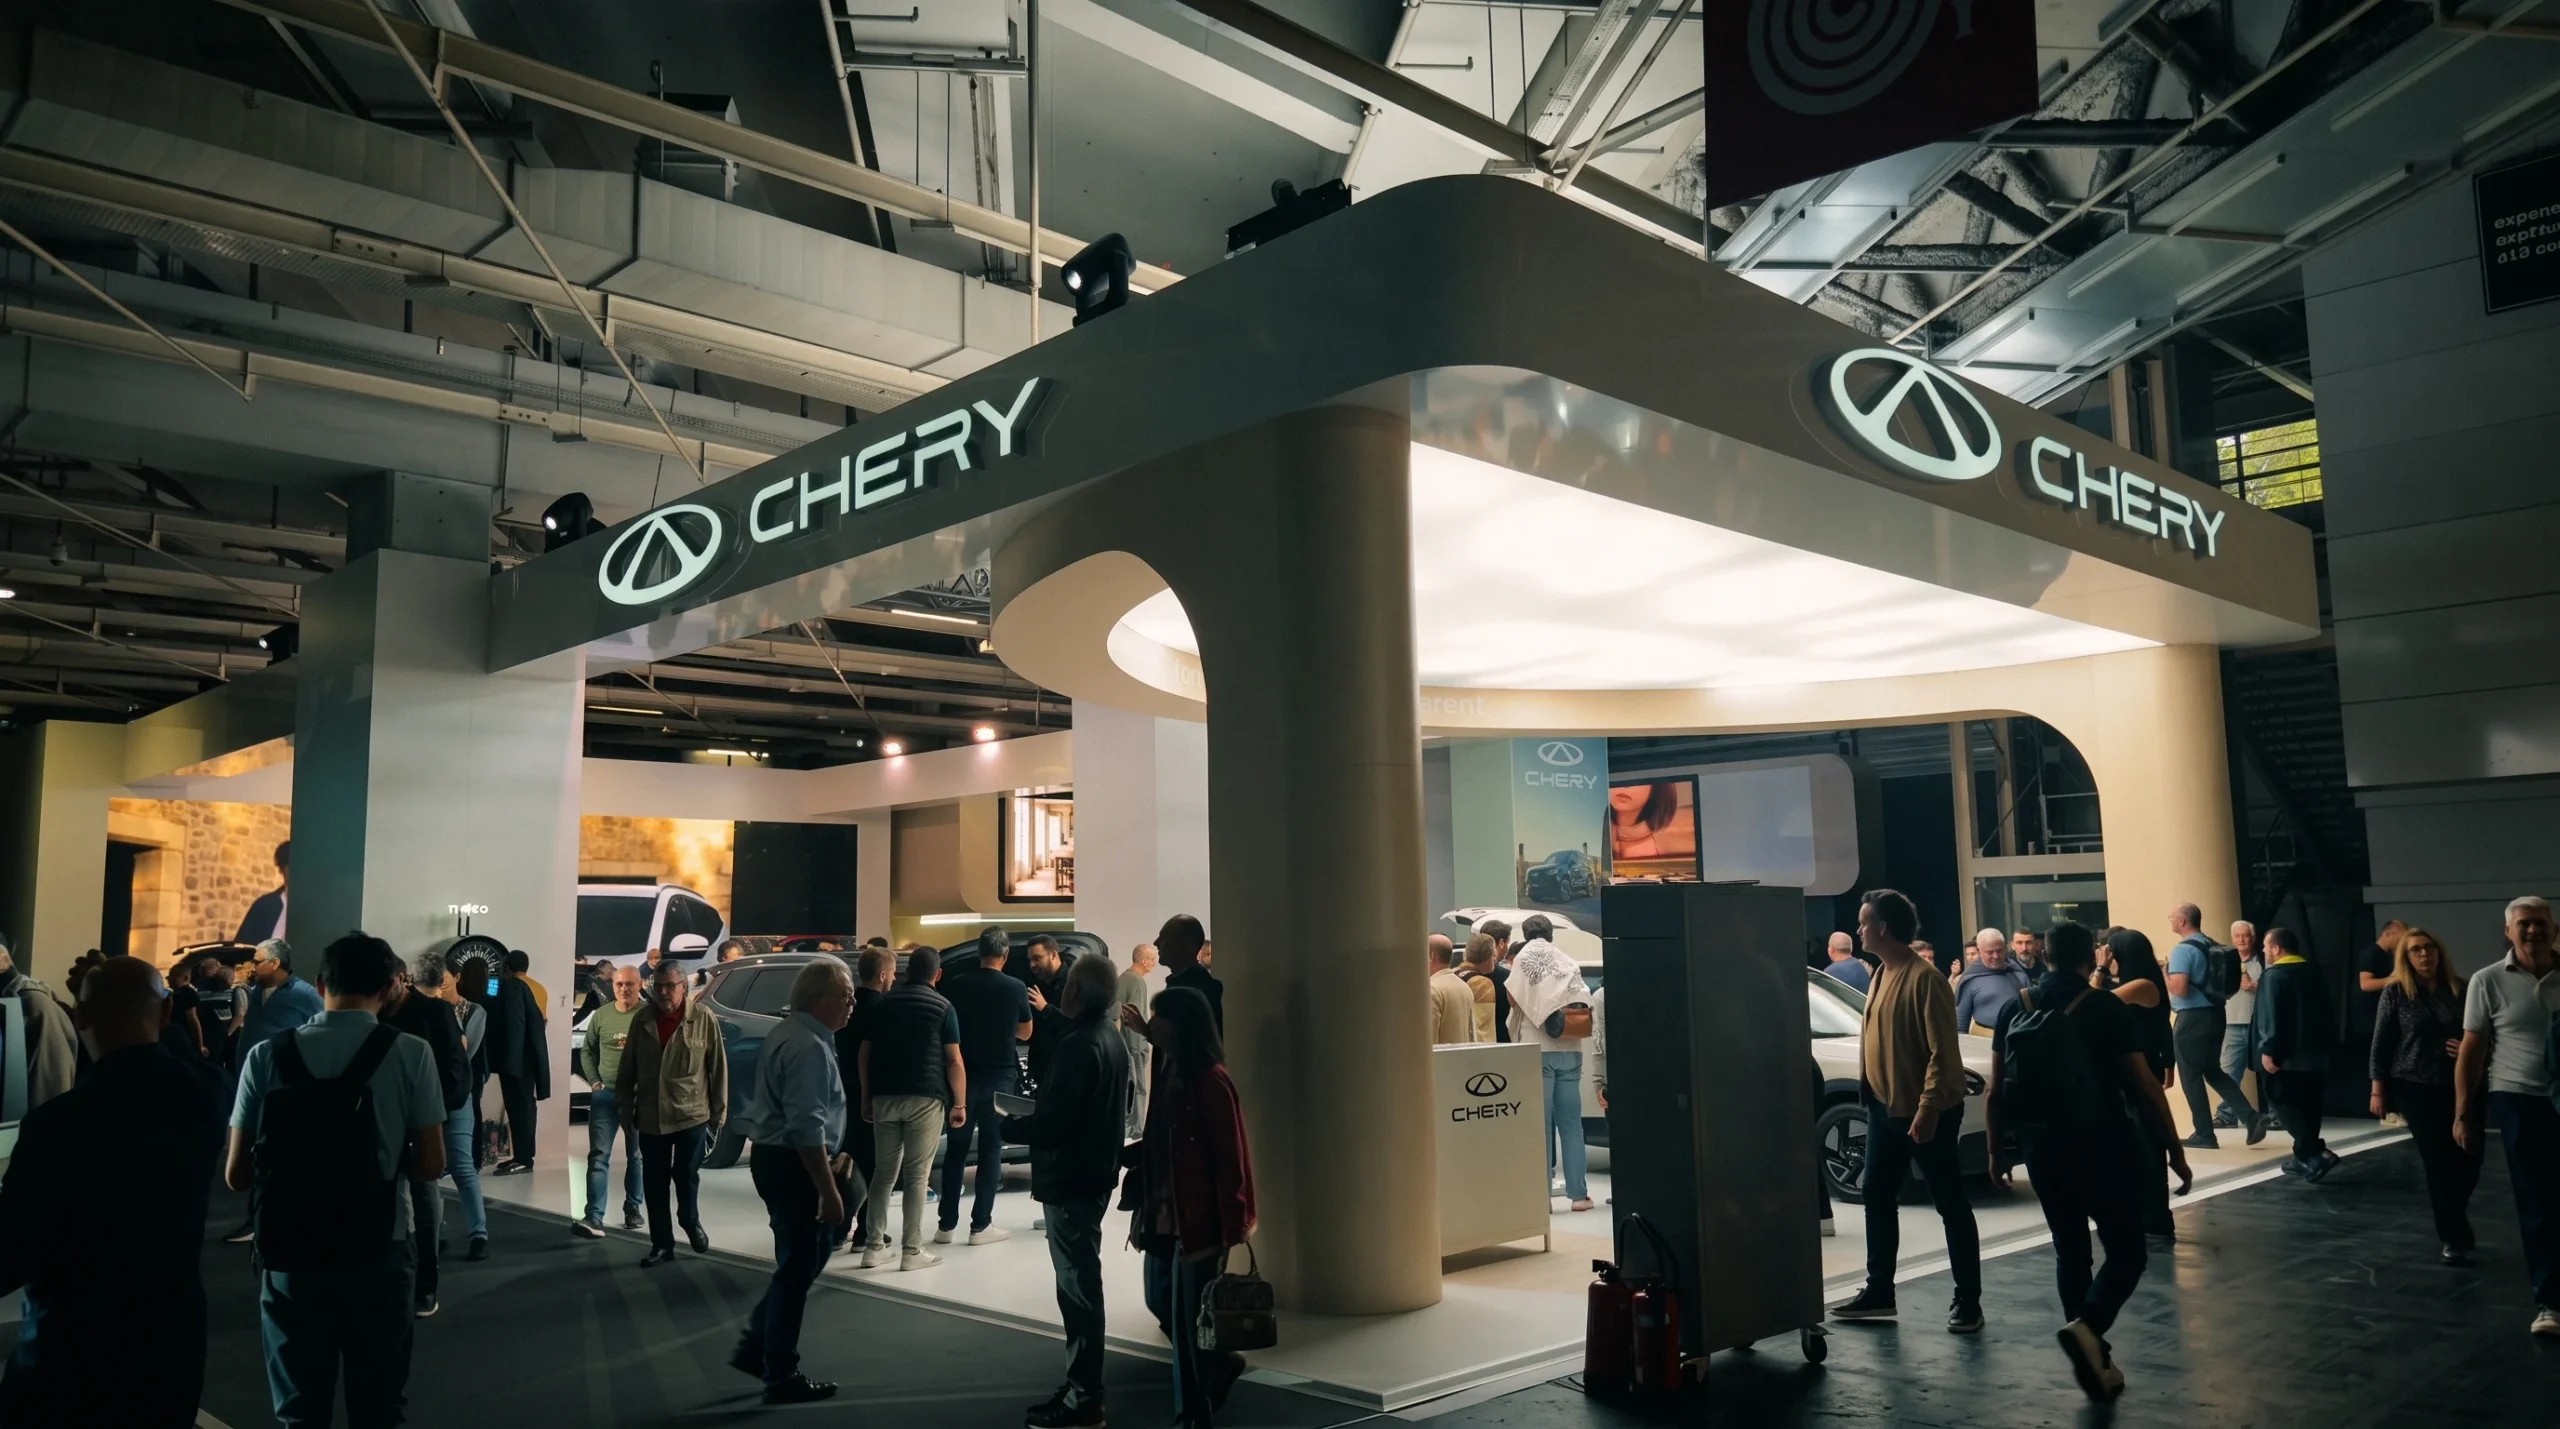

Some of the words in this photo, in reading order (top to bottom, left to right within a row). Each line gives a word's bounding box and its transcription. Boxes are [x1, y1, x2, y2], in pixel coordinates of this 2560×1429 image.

[749, 376, 1040, 544] CHERY
[2030, 435, 2225, 557] CHERY
[1524, 770, 1598, 790] CHERY
[1451, 1101, 1522, 1122] CHERY
